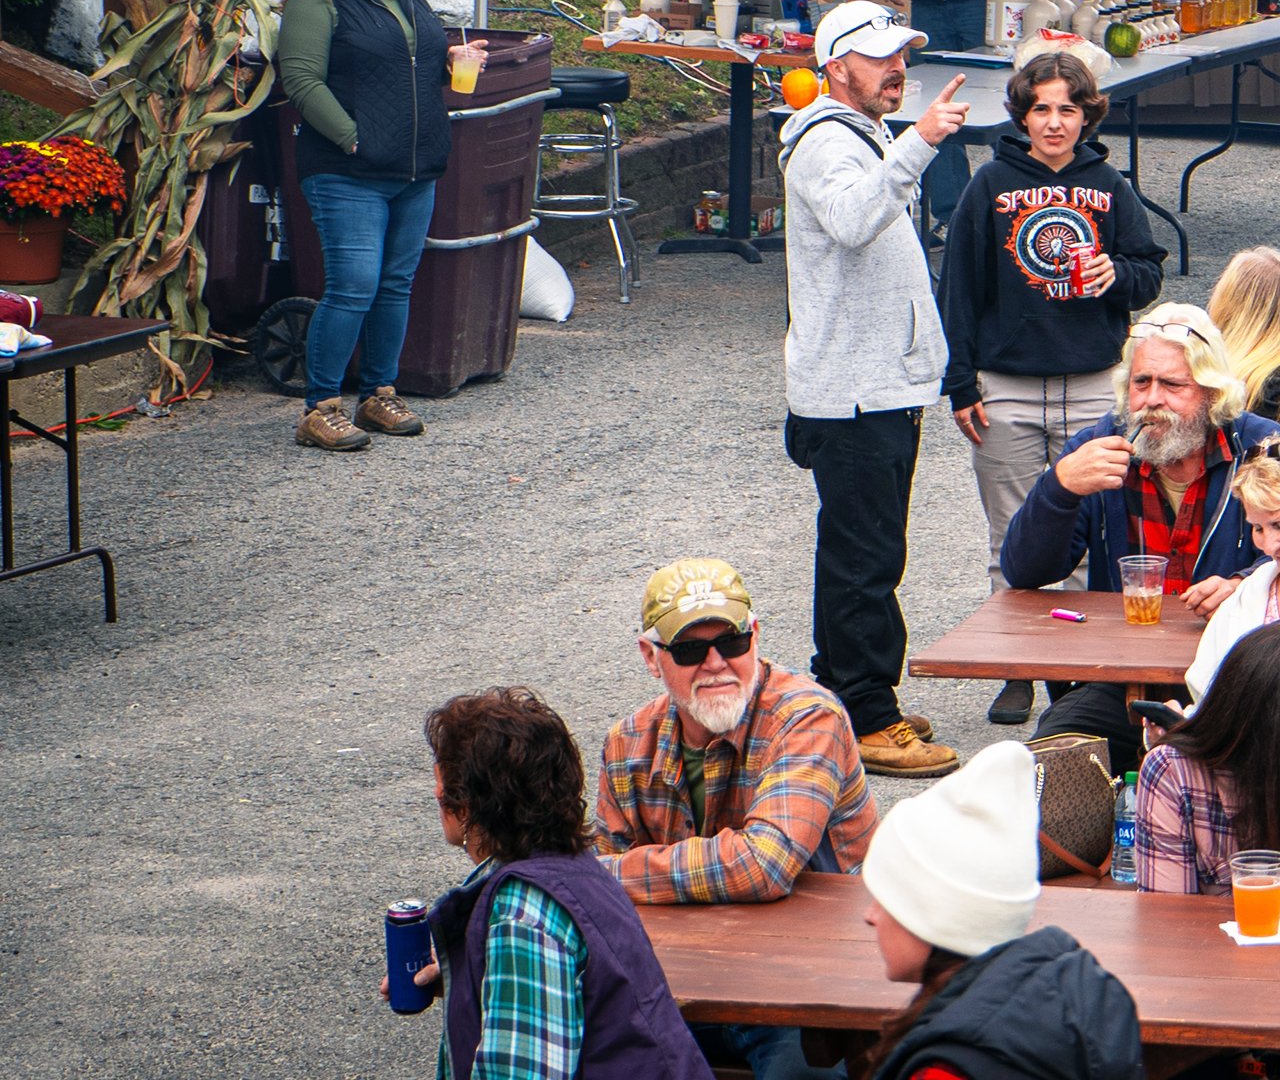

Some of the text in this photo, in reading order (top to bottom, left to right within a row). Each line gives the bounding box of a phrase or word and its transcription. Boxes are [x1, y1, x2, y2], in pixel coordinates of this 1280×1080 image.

[996, 185, 1114, 213] SPUD'S RUN
[1045, 282, 1070, 298] VII
[1119, 826, 1135, 841] DAS
